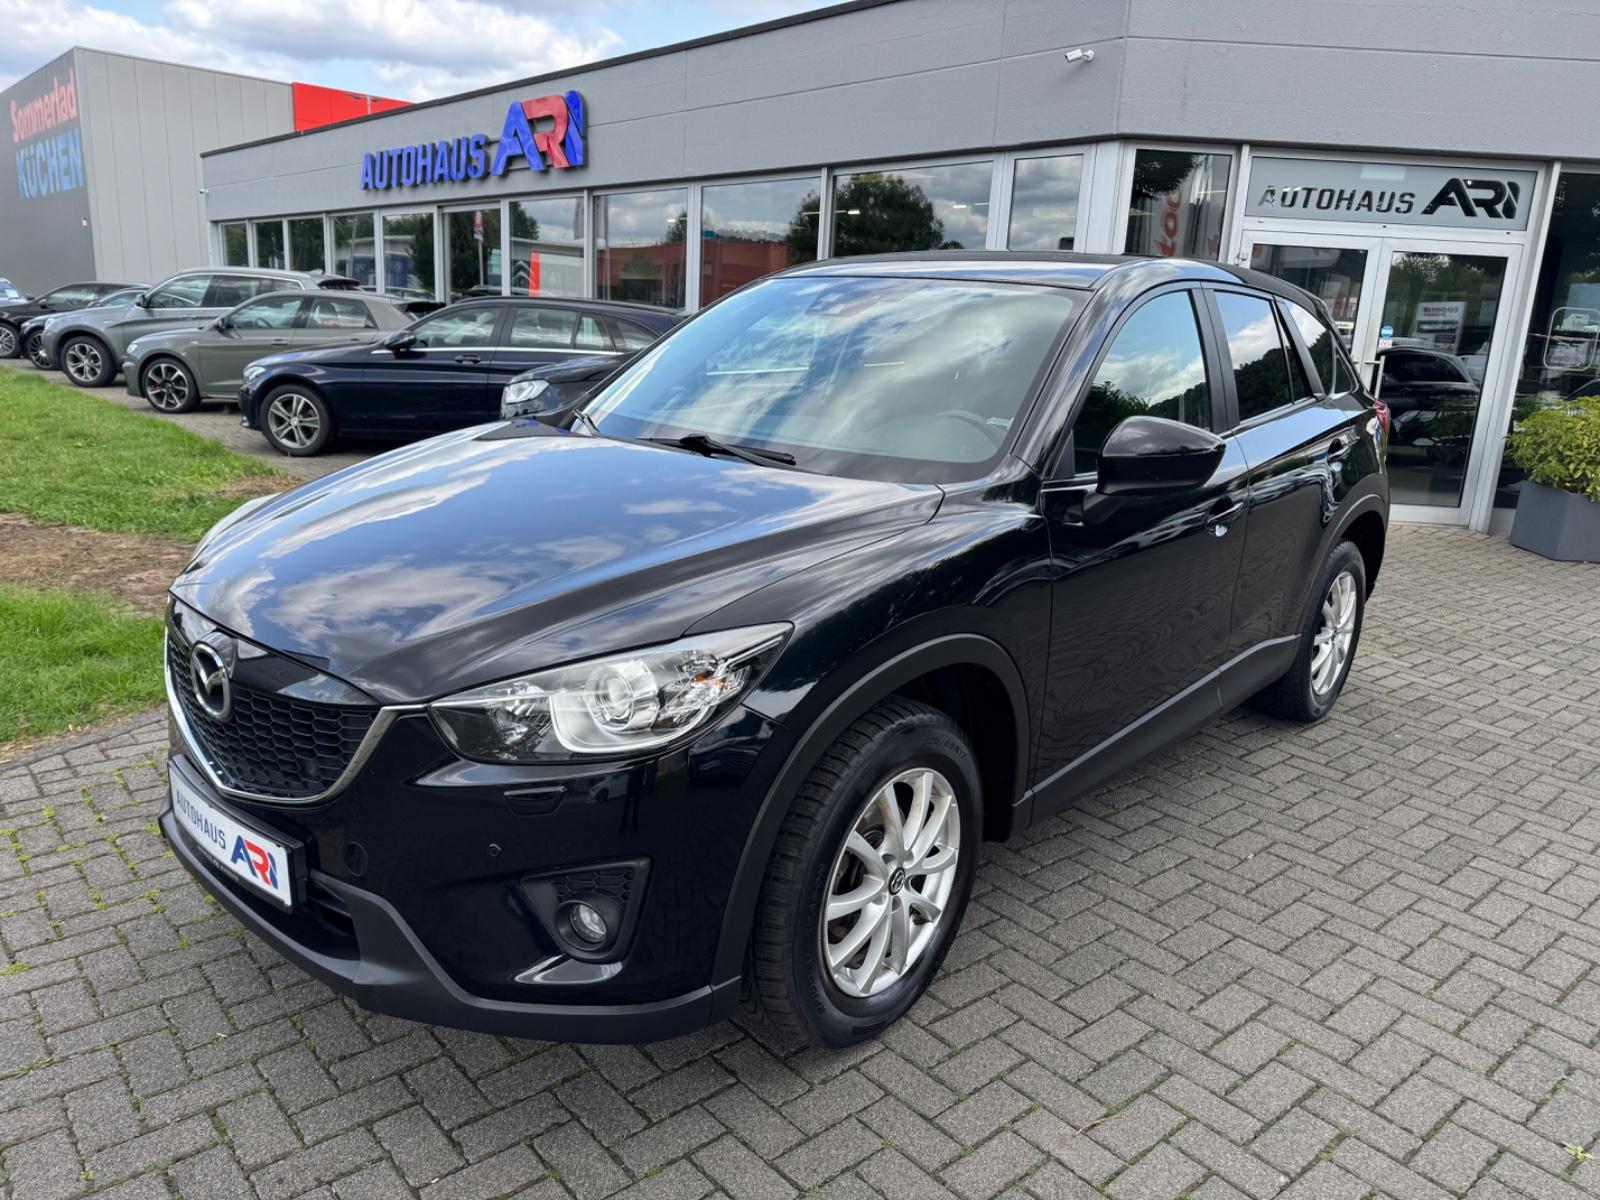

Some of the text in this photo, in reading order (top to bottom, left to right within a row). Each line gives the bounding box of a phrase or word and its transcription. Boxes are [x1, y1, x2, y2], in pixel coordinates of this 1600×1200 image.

[10, 68, 78, 142] Sommerlad
[360, 90, 586, 191] AUTOHAUS ARI
[16, 128, 84, 199] KÜCHEN
[1258, 177, 1521, 220] AUTOHAUS ARI
[176, 790, 226, 850] AUTOHAUS
[230, 835, 279, 890] ARI
